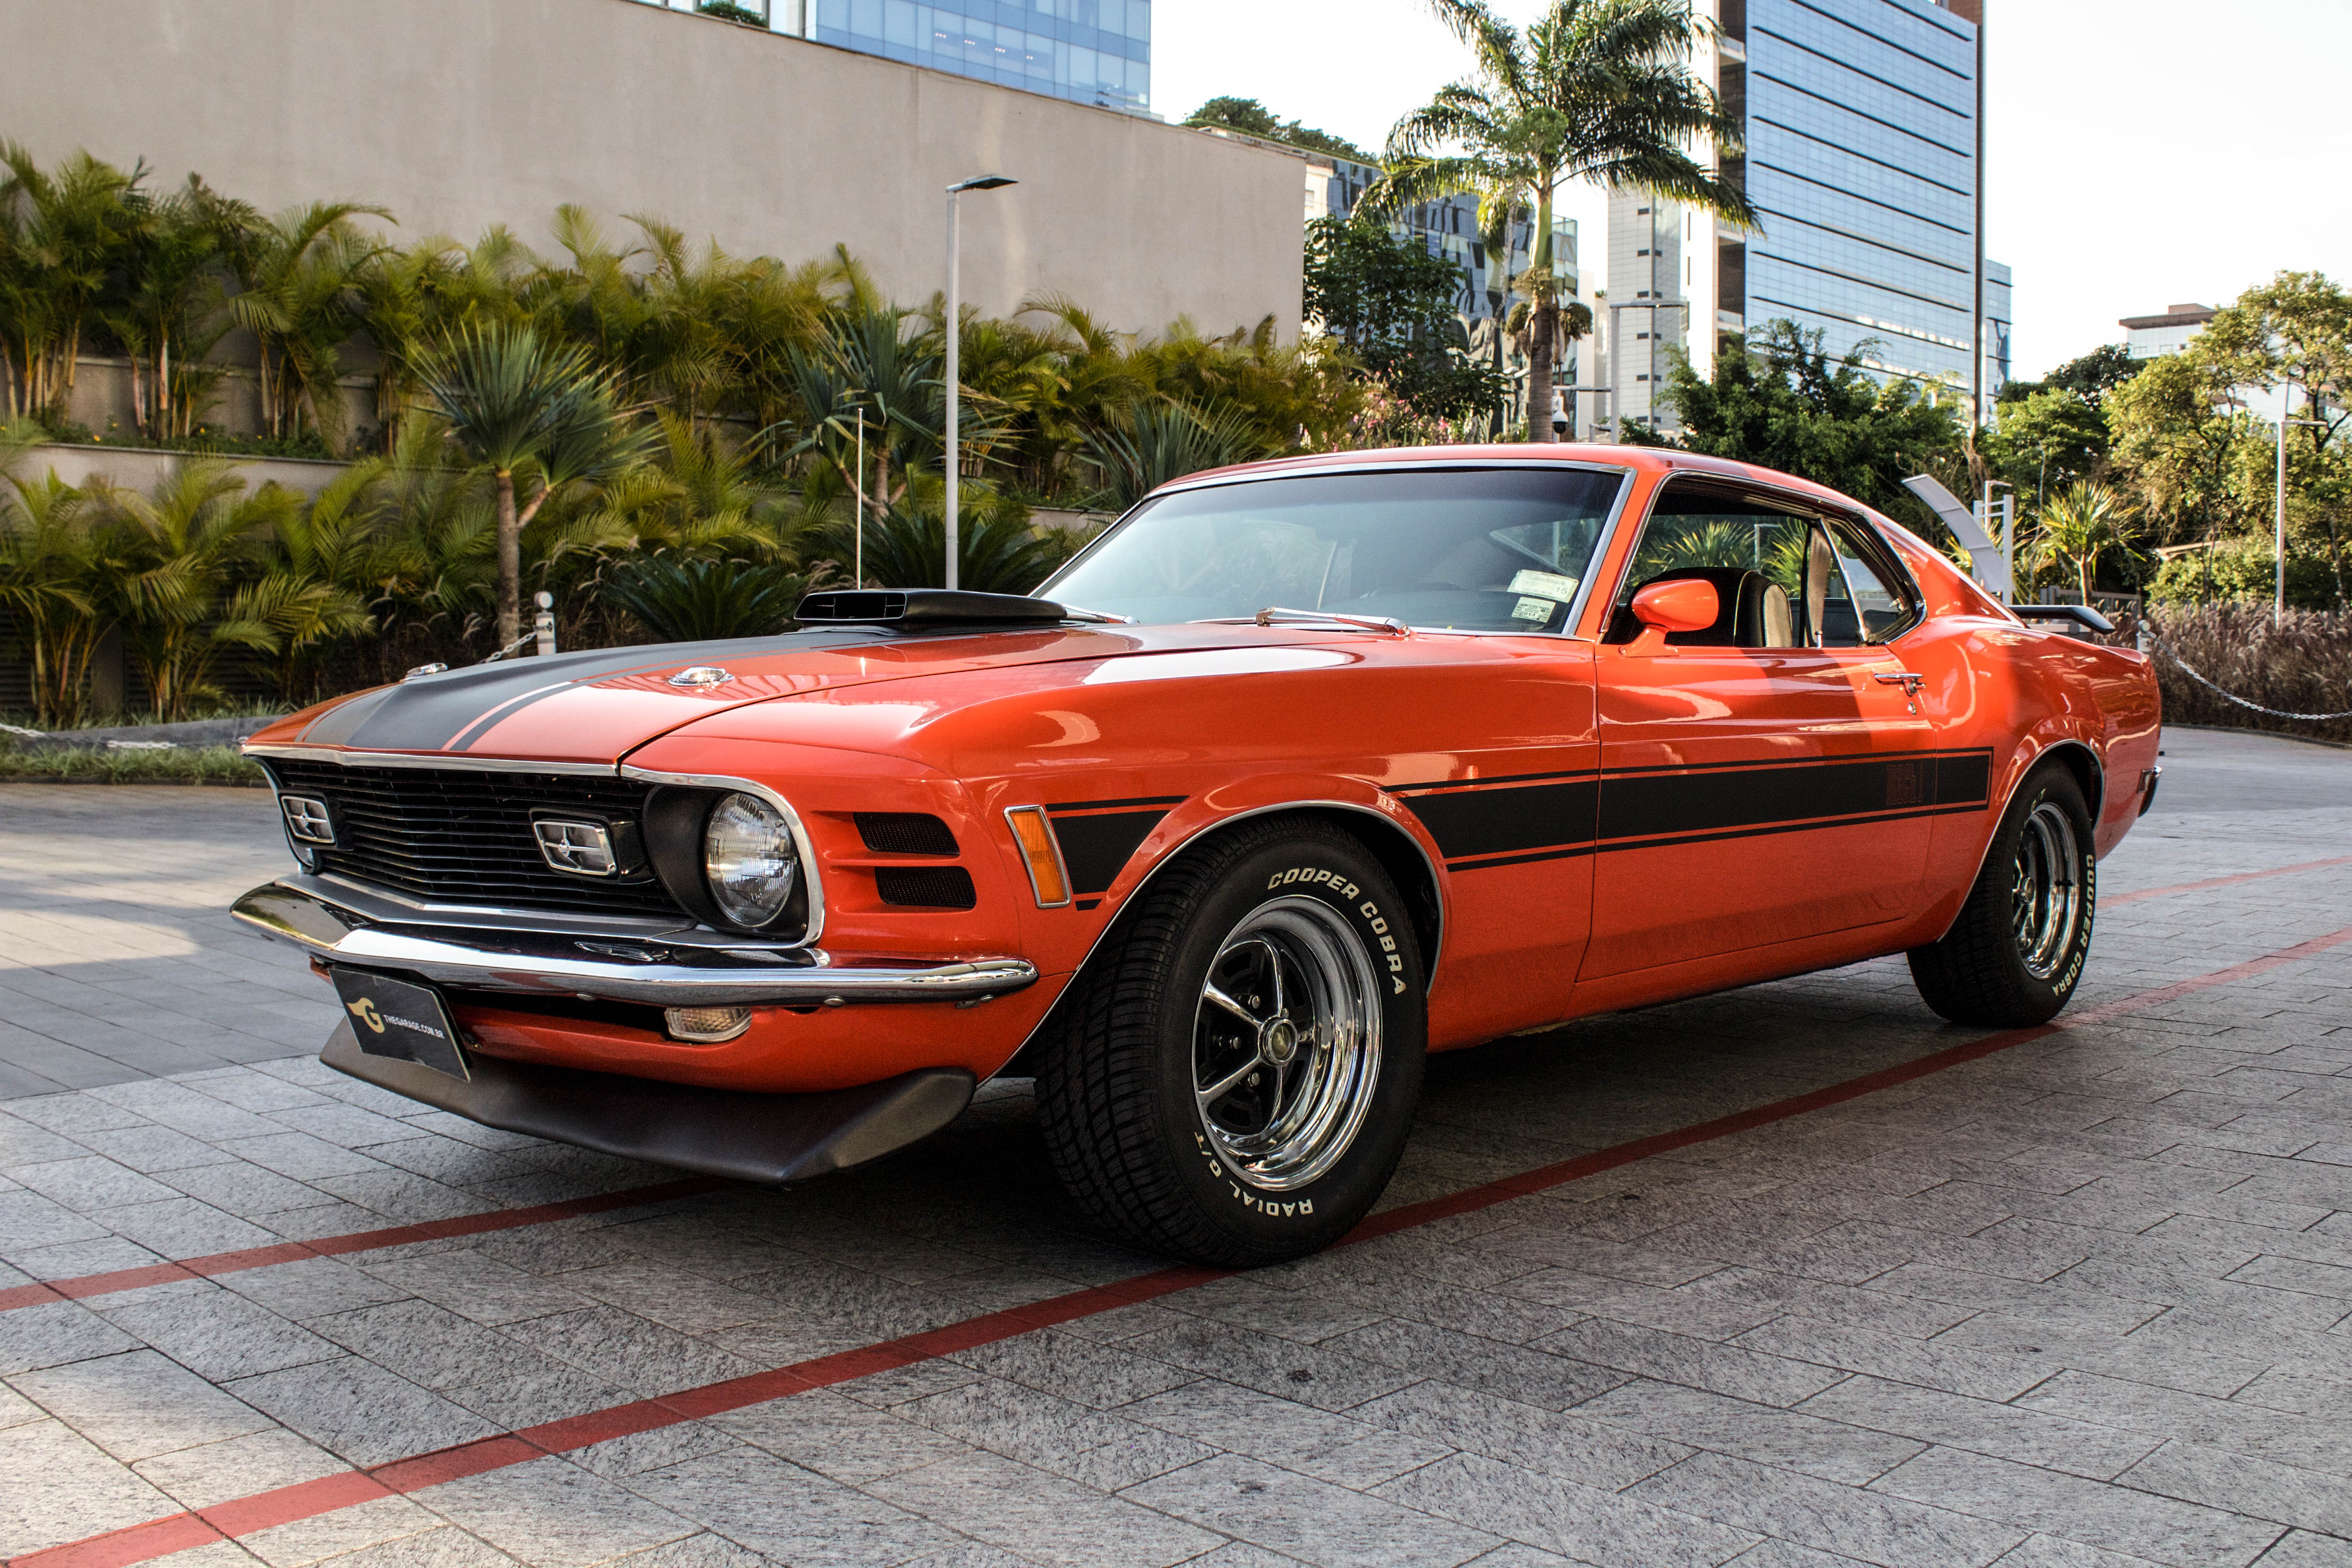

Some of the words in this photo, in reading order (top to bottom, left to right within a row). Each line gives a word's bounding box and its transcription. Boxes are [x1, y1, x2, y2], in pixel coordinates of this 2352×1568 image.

[2079, 854, 2095, 949] COOPER
[1267, 867, 1360, 900] COOPER
[1359, 901, 1407, 995] COBRA
[2052, 951, 2083, 997] COBRA
[383, 1014, 445, 1040] THEGARAGE.COM.BR
[1194, 1131, 1222, 1177] G/T
[1228, 1179, 1313, 1217] RADIAL
